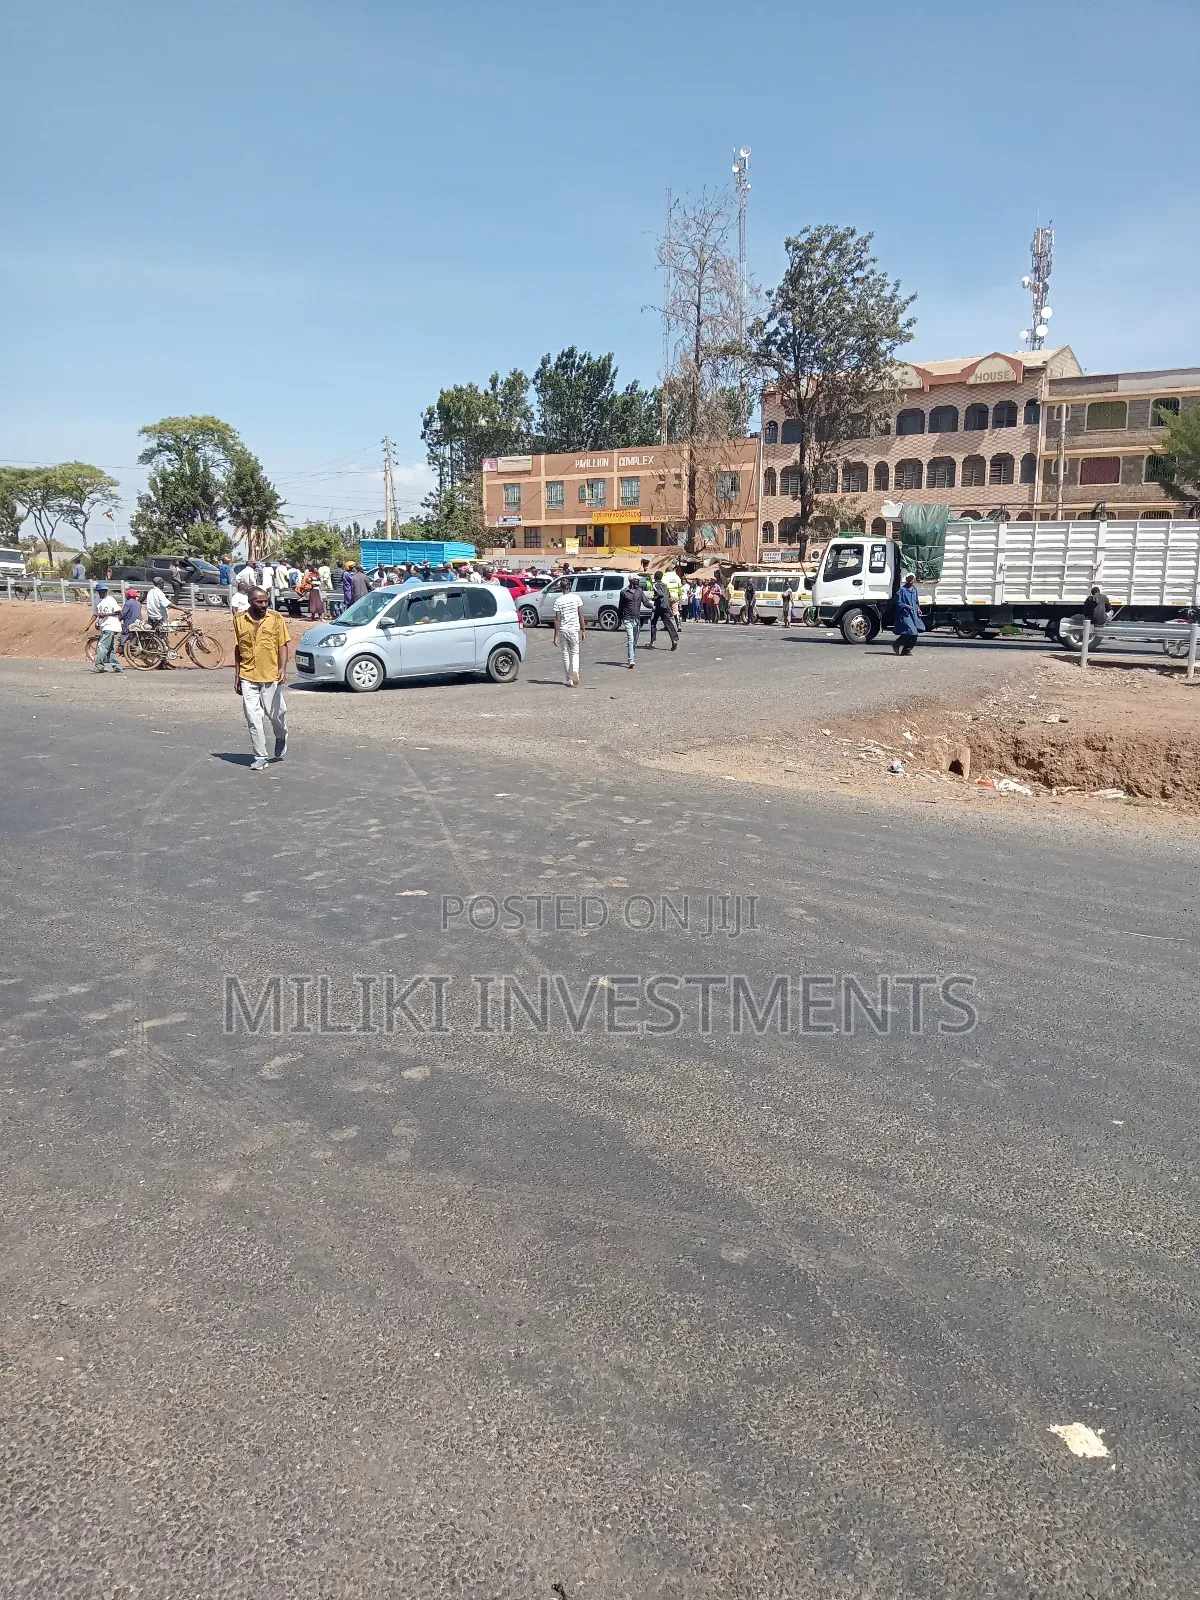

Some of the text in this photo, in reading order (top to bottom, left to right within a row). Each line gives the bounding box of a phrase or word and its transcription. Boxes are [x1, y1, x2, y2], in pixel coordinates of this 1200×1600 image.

[974, 370, 1011, 382] HOUSE
[575, 455, 655, 469] PAVILLION COMPLEX
